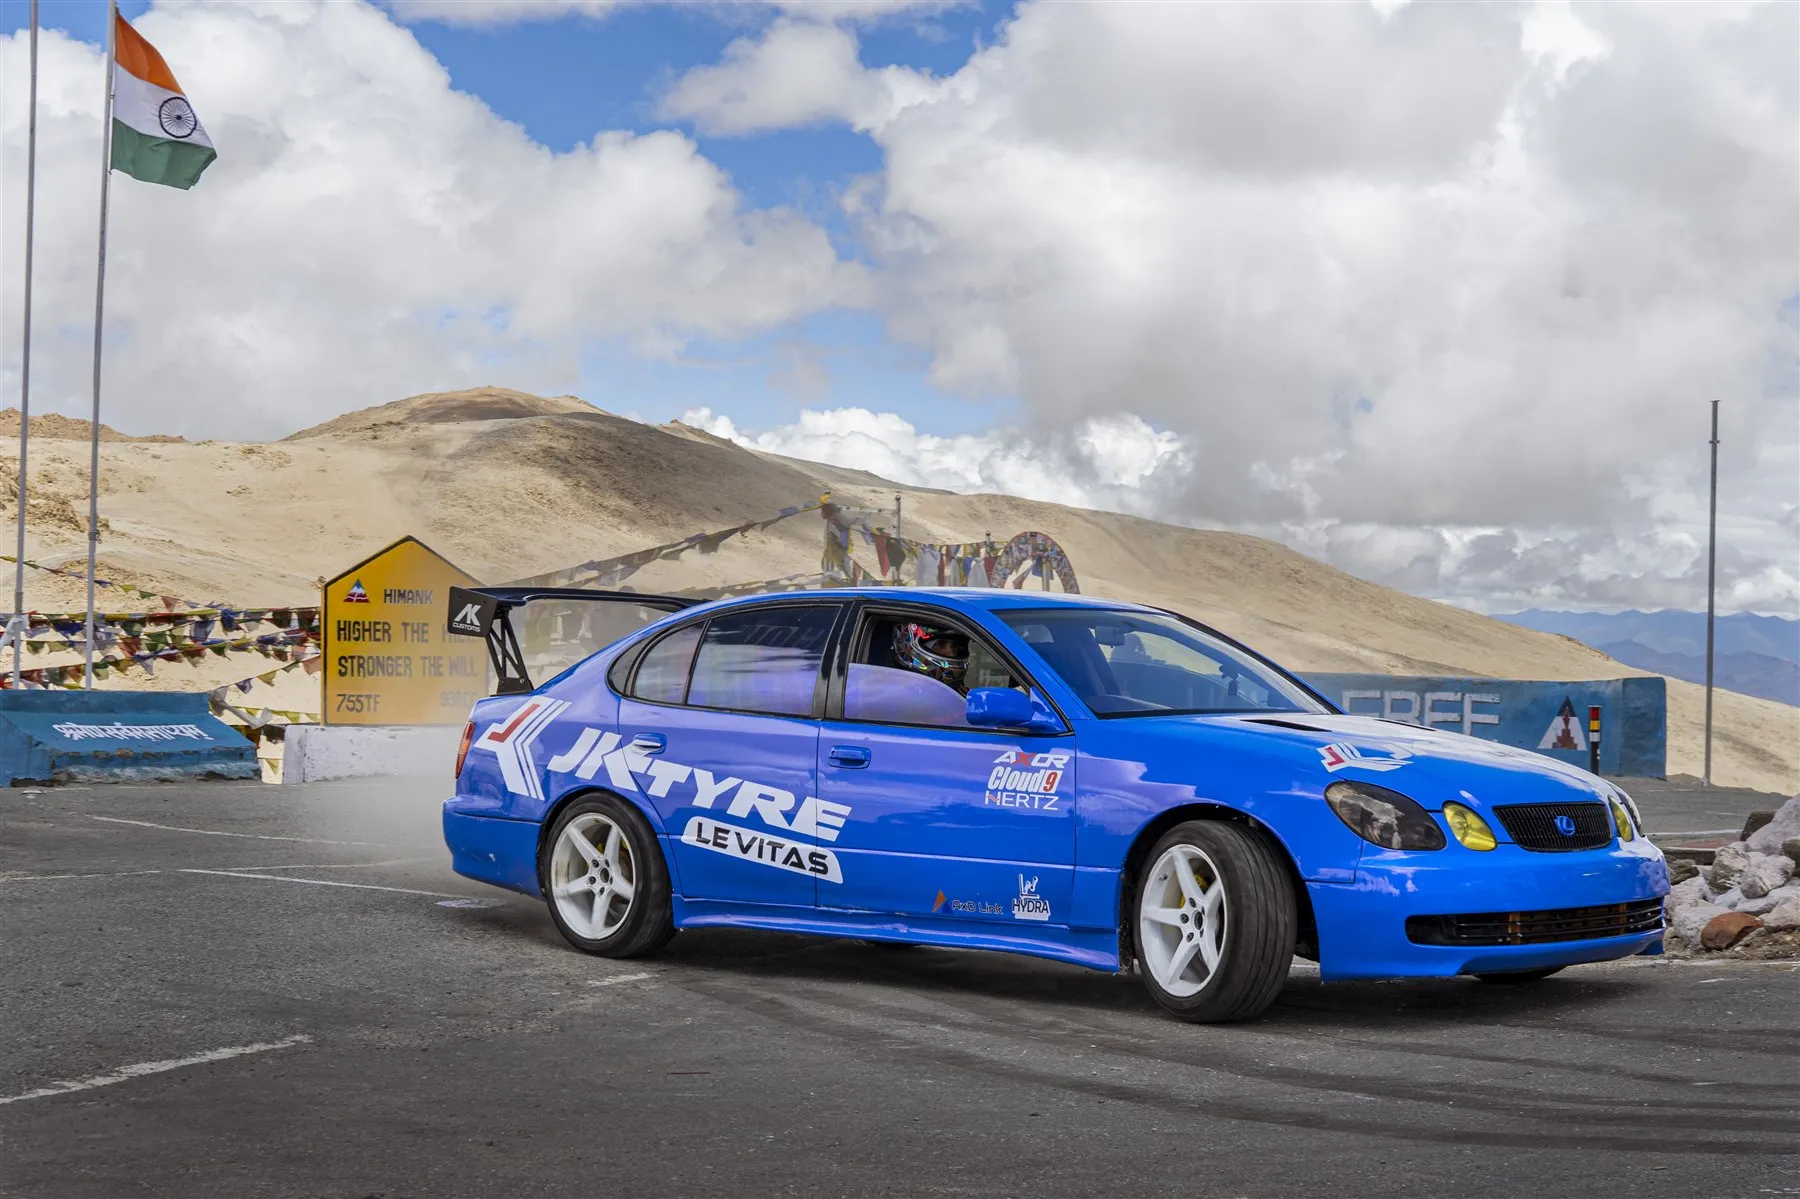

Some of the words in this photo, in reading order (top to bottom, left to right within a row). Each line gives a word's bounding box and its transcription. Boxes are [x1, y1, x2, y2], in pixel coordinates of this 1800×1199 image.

[384, 588, 433, 604] HIMANK
[453, 603, 482, 627] AK
[337, 620, 391, 643] HIGHER
[402, 622, 429, 643] THE
[452, 621, 481, 633] CUSTOMS
[337, 656, 412, 678] STRONGER
[420, 656, 444, 678] THE
[449, 655, 479, 677] WILL
[985, 791, 1059, 811] HERTZ
[695, 821, 829, 876] LEVITAS
[1012, 898, 1049, 914] HYDRA
